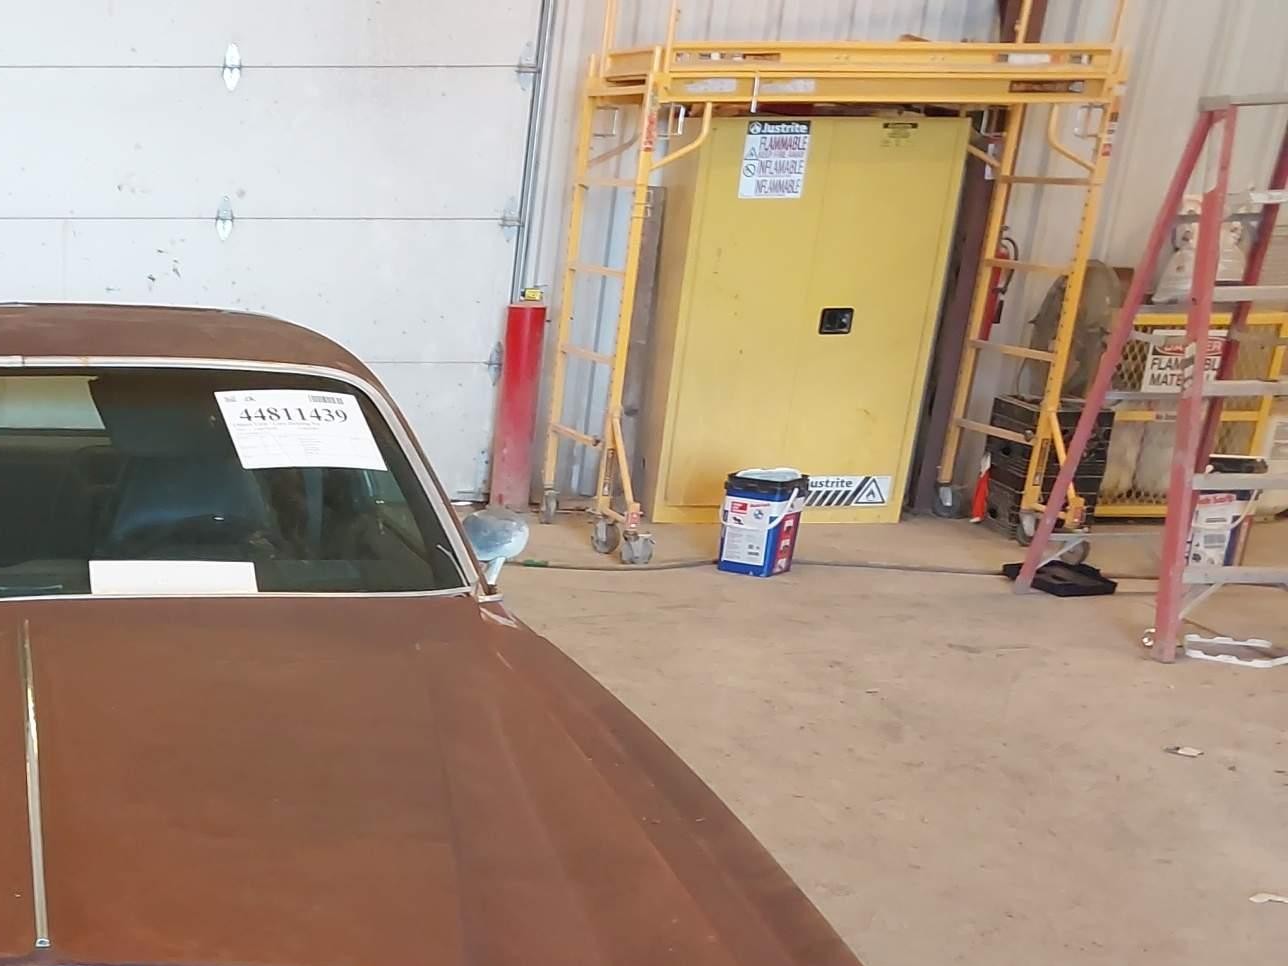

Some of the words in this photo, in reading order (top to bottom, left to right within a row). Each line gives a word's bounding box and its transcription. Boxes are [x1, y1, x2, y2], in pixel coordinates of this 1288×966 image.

[761, 122, 809, 134] Justrite
[759, 136, 808, 151] FLAMMABLE
[239, 407, 348, 423] 44811439
[811, 477, 854, 489] ustrite
